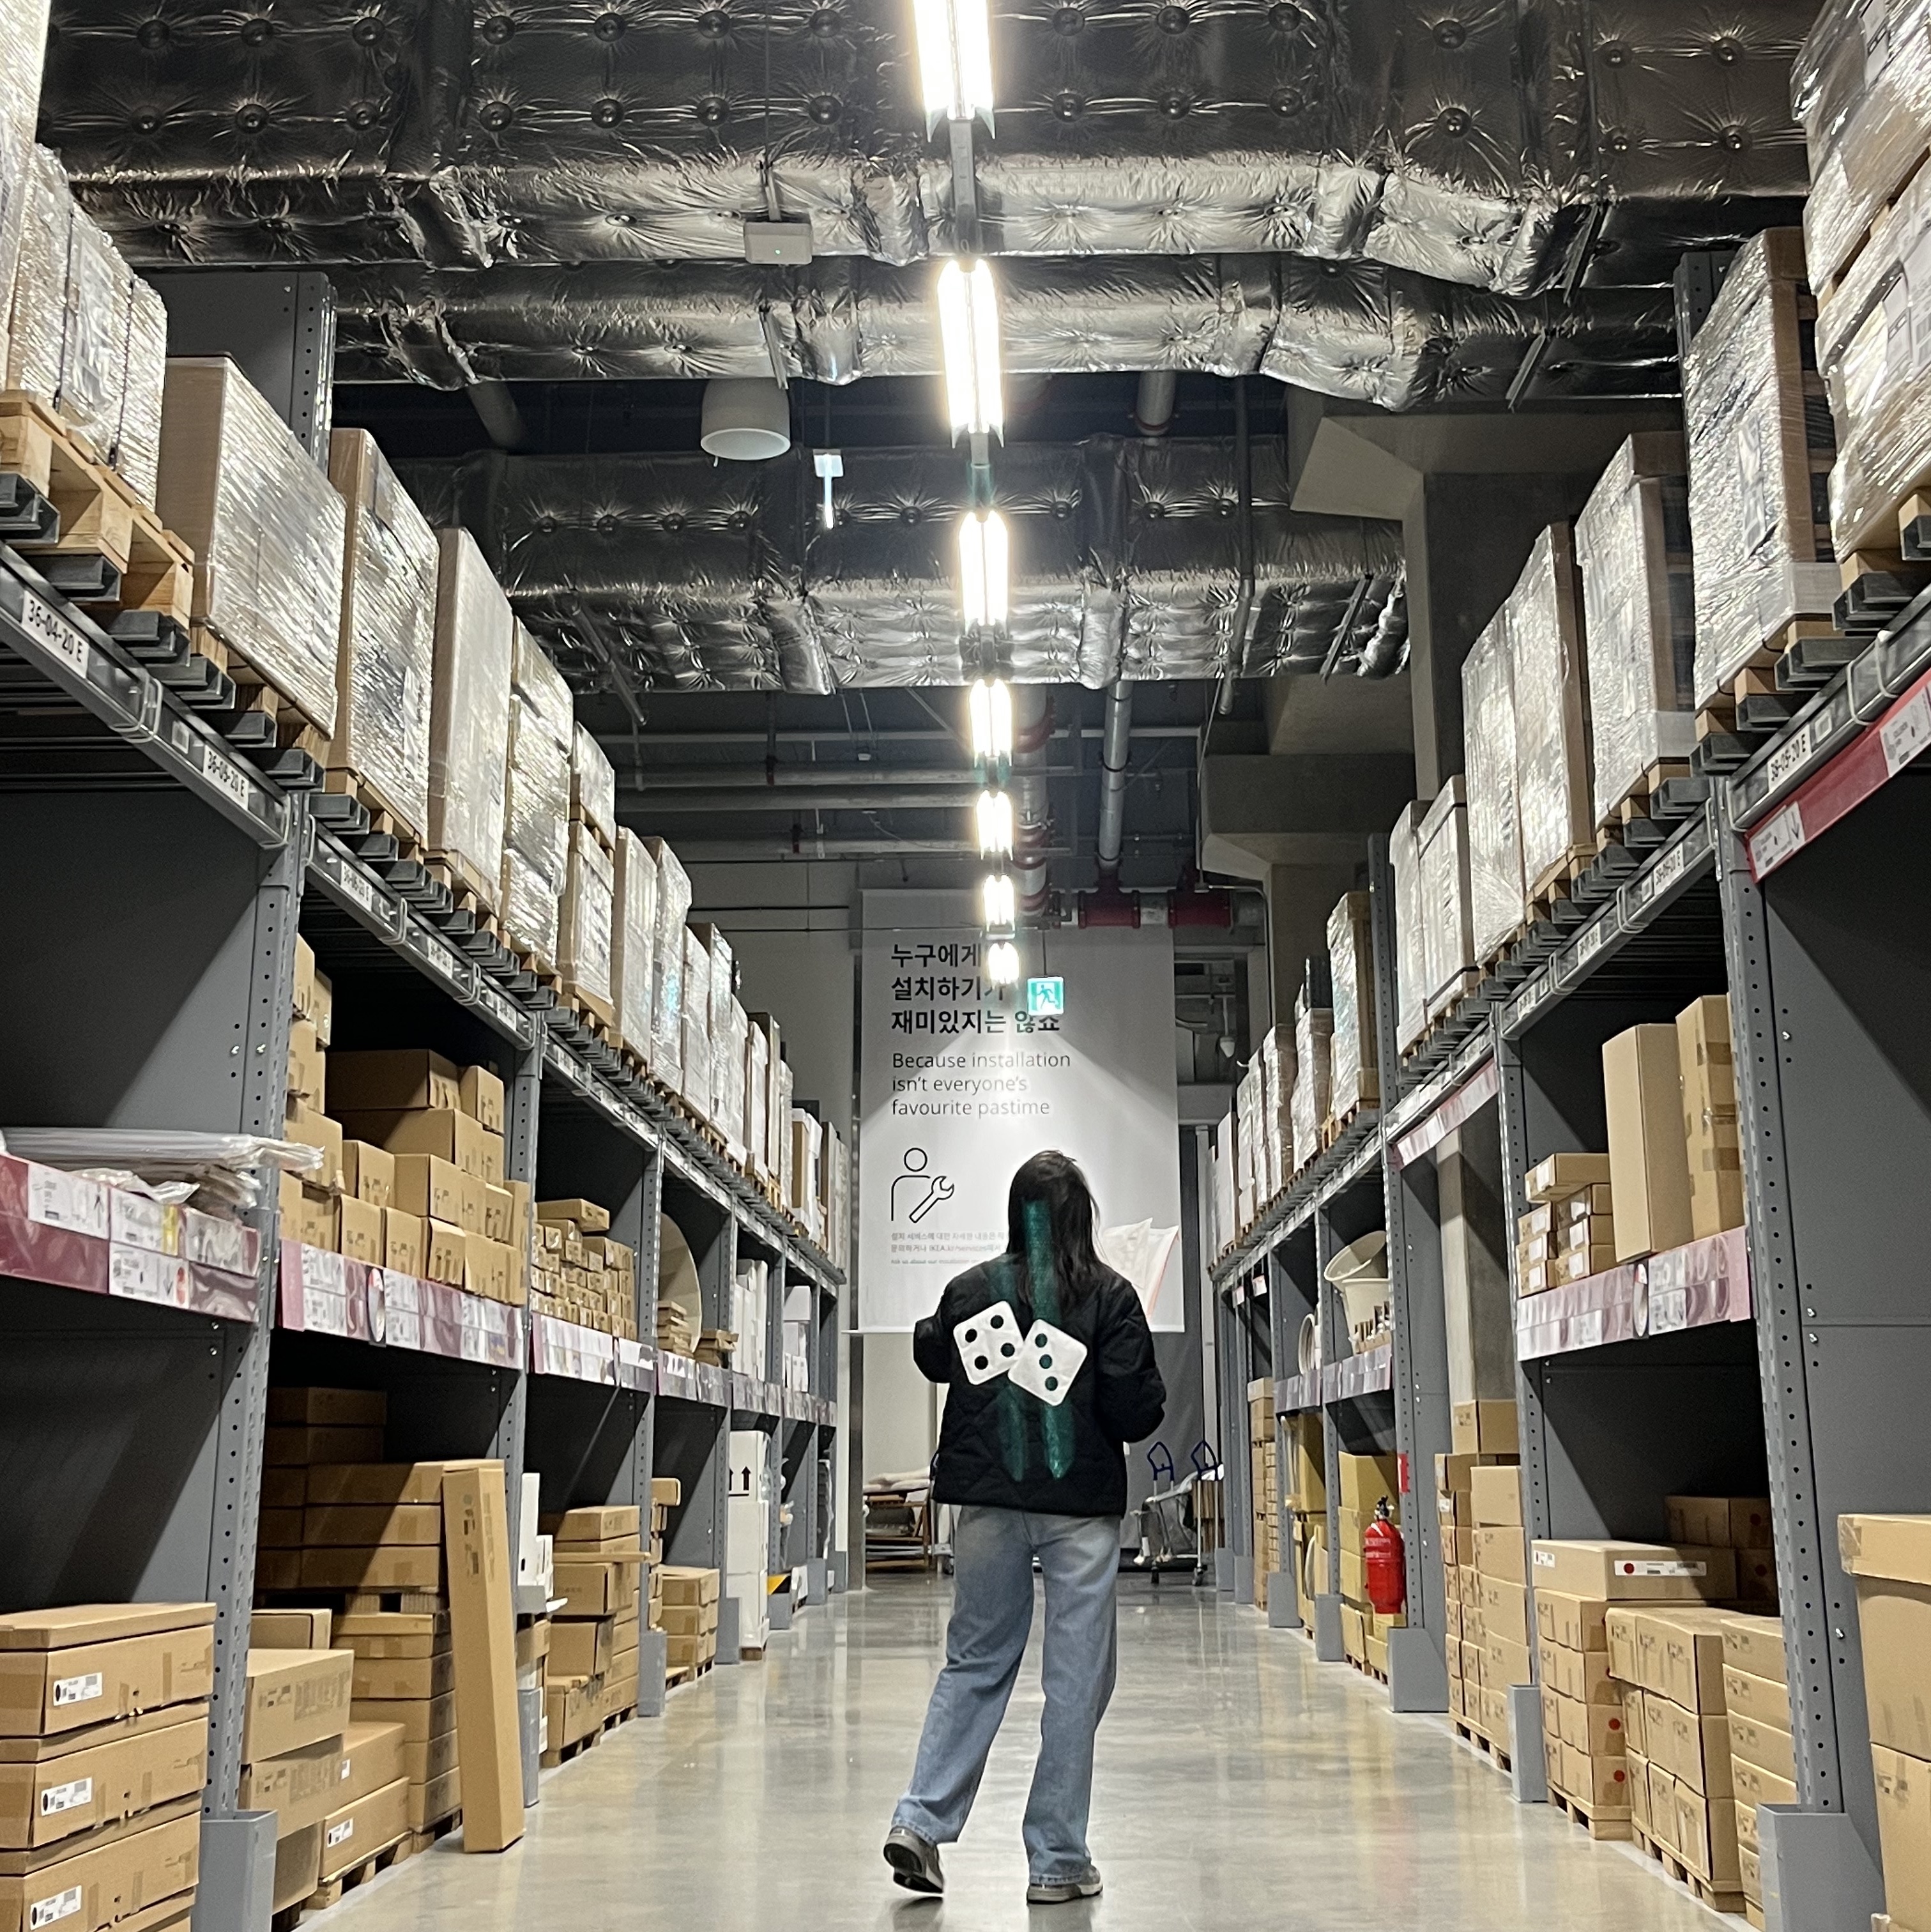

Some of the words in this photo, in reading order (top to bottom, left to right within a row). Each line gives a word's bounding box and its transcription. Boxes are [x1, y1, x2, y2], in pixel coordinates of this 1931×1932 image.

[28, 599, 74, 655] 36-04-20
[76, 640, 82, 663] E
[891, 943, 982, 968] 누구에게
[891, 1009, 1007, 1034] 재미있지는
[892, 1052, 966, 1068] Because
[972, 1052, 1071, 1068] installation
[892, 1099, 972, 1116] favourite
[979, 1099, 1050, 1119] pastime
